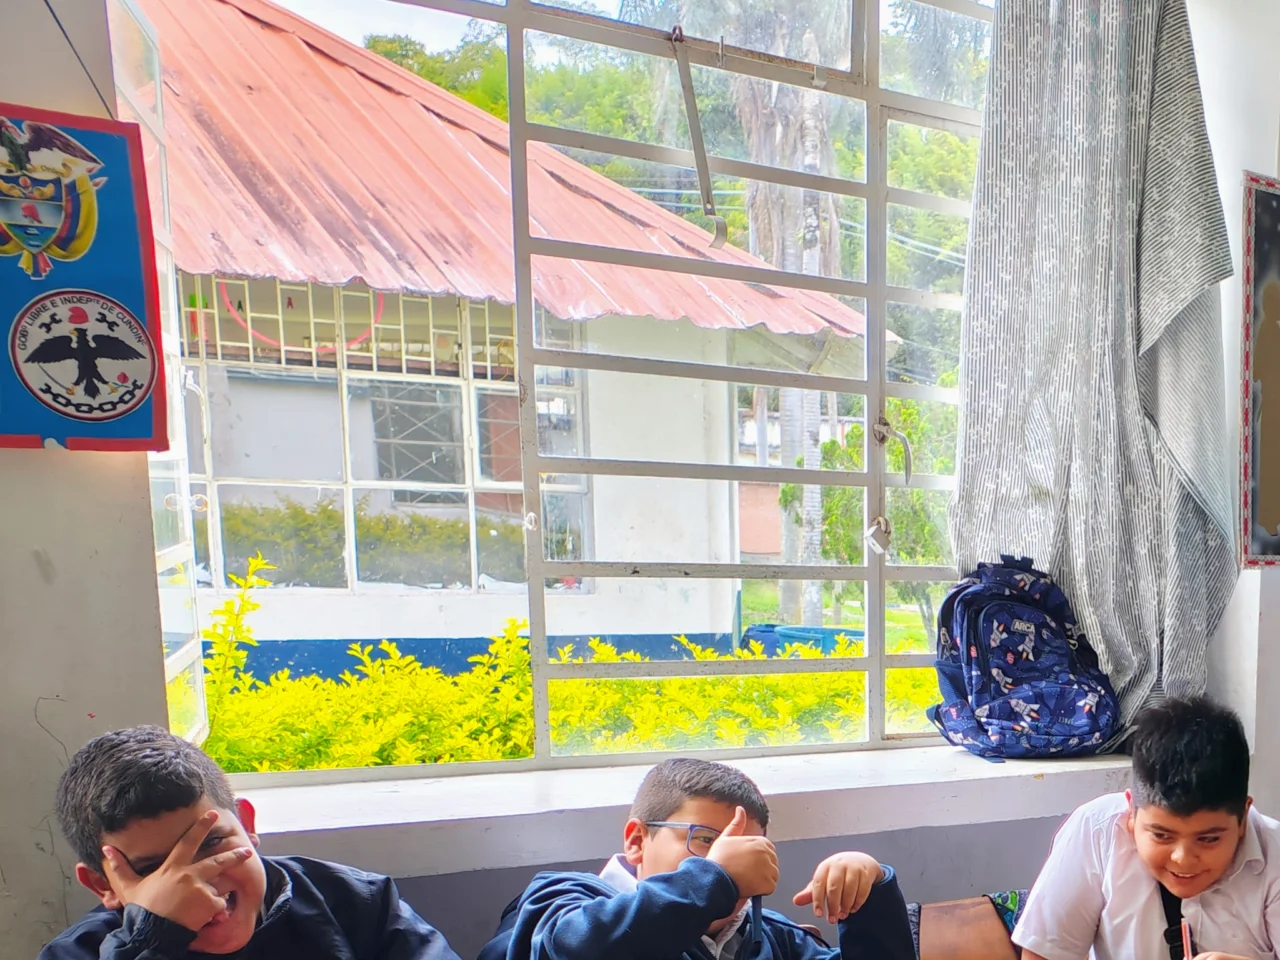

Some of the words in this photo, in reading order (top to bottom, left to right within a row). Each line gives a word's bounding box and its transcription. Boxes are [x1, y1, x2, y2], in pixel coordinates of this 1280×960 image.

[27, 303, 50, 326] LIBRE
[50, 299, 59, 308] E
[100, 302, 116, 314] DE
